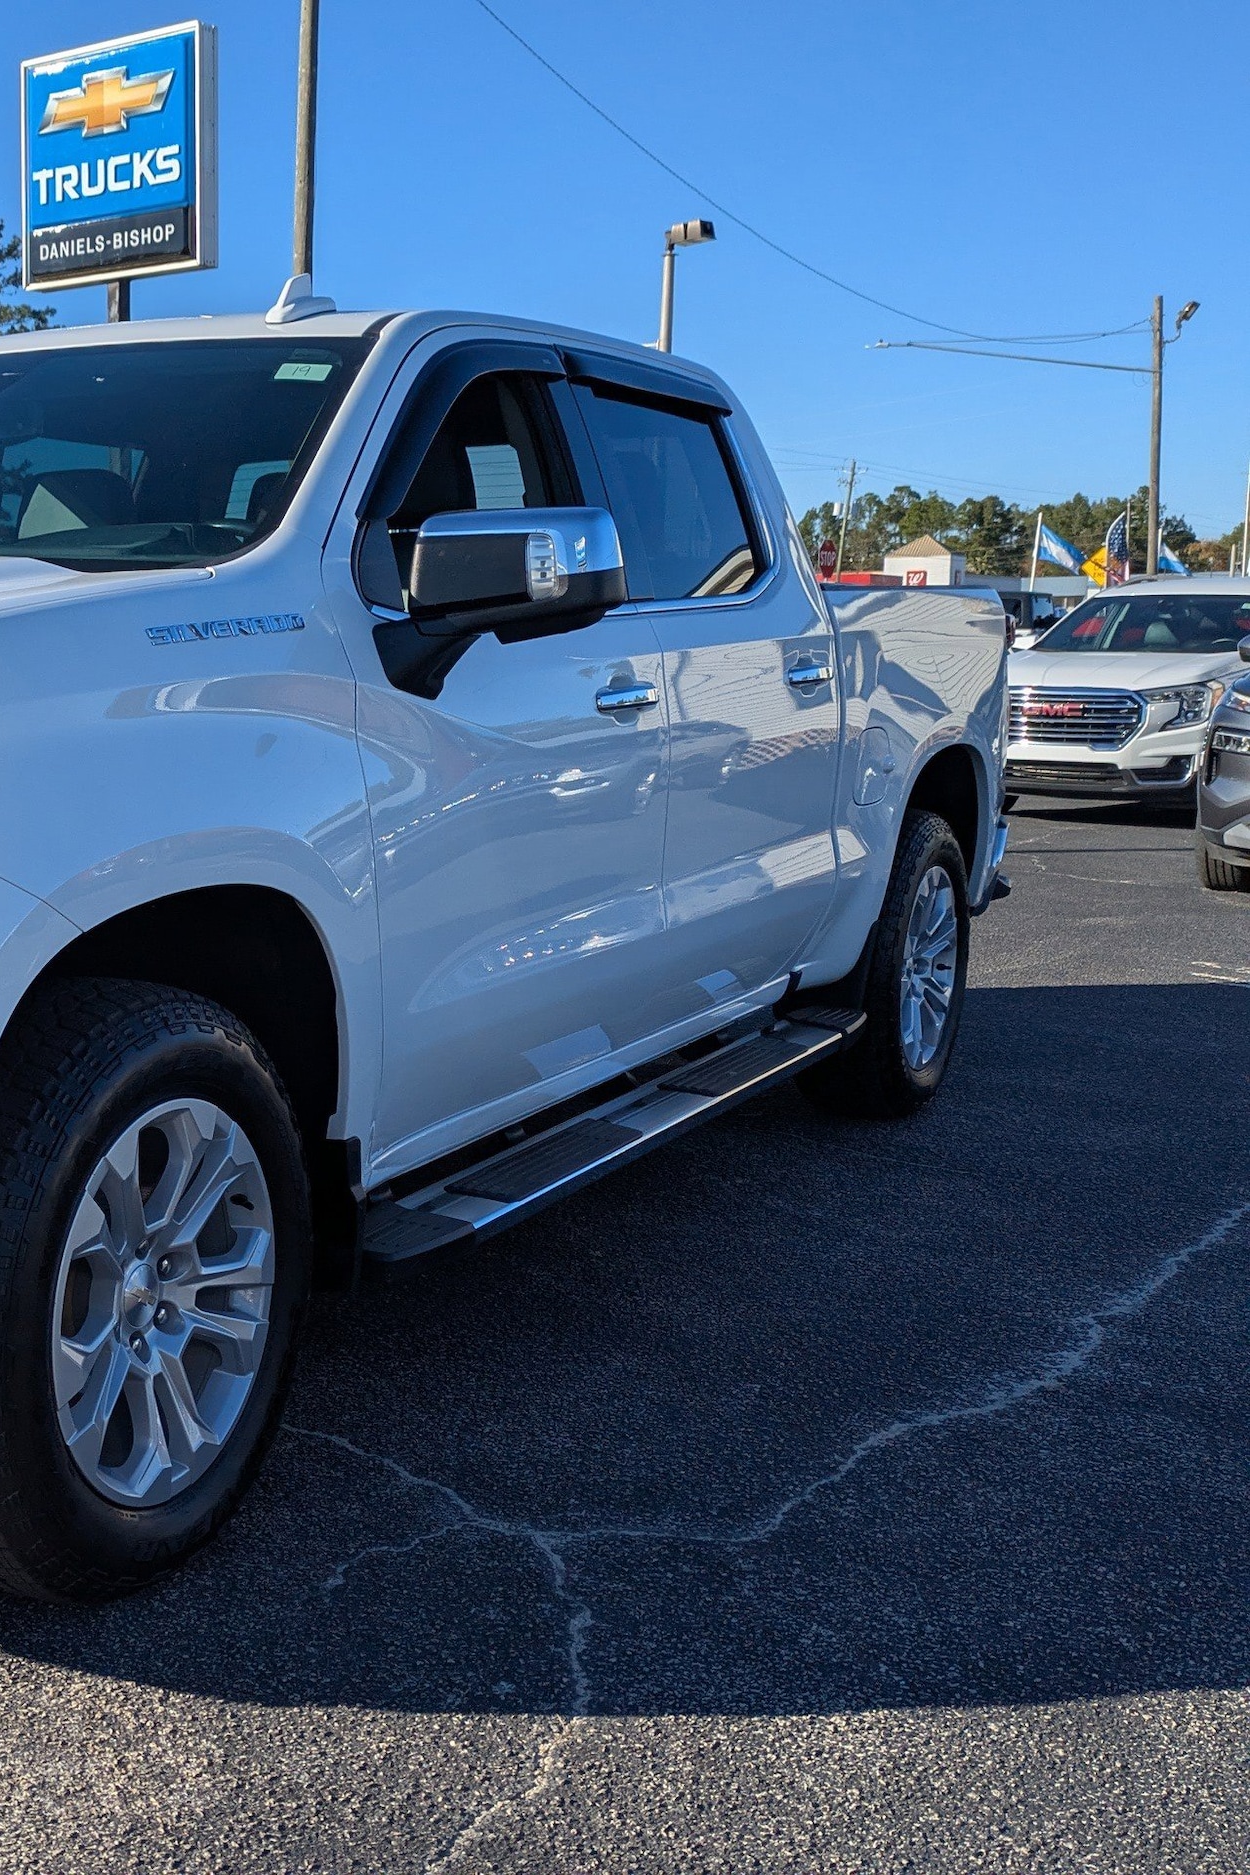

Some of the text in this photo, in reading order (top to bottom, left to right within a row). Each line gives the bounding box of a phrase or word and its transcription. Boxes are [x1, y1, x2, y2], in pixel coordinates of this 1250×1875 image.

[33, 144, 181, 205] TRUCKS
[39, 223, 175, 261] DANIELS-BISHOP
[292, 365, 311, 377] 19
[820, 550, 837, 567] STOP
[145, 613, 305, 646] SILVERADO
[1022, 702, 1084, 717] GMC
